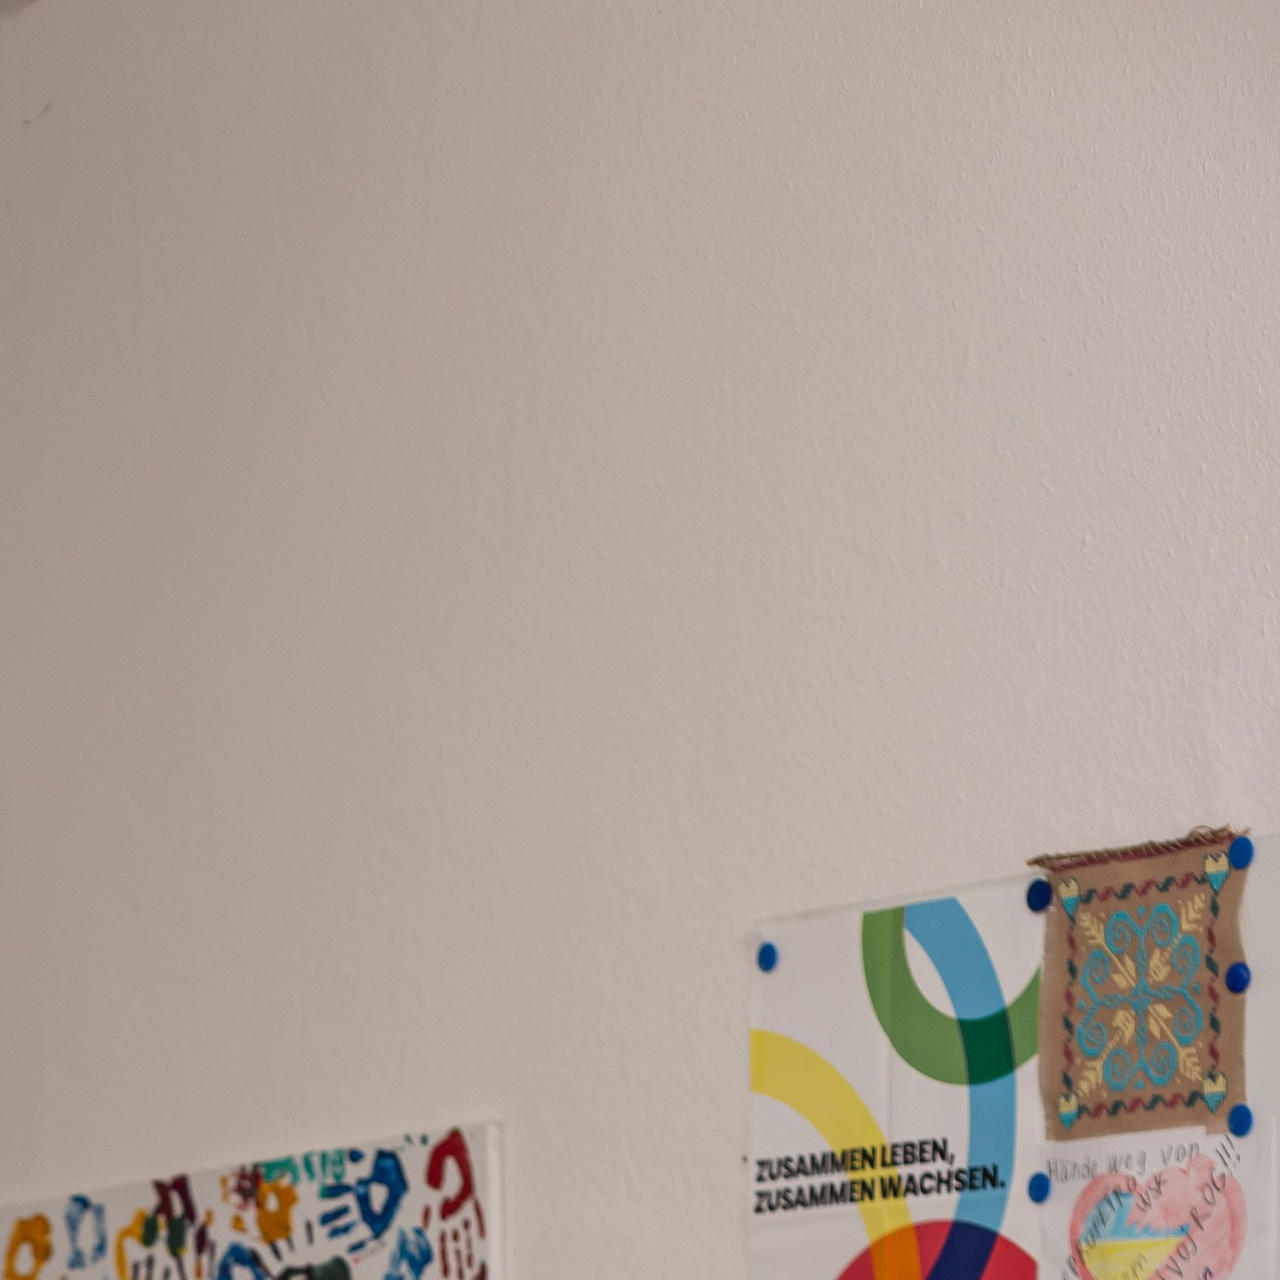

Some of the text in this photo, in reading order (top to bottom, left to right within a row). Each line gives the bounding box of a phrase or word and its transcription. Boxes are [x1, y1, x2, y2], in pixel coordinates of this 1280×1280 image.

[755, 1137, 955, 1183] ZUSAMMEN LEBEN,
[1160, 1141, 1201, 1165] von
[754, 1163, 1006, 1214] ZUSAMMEN WACHSEN.
